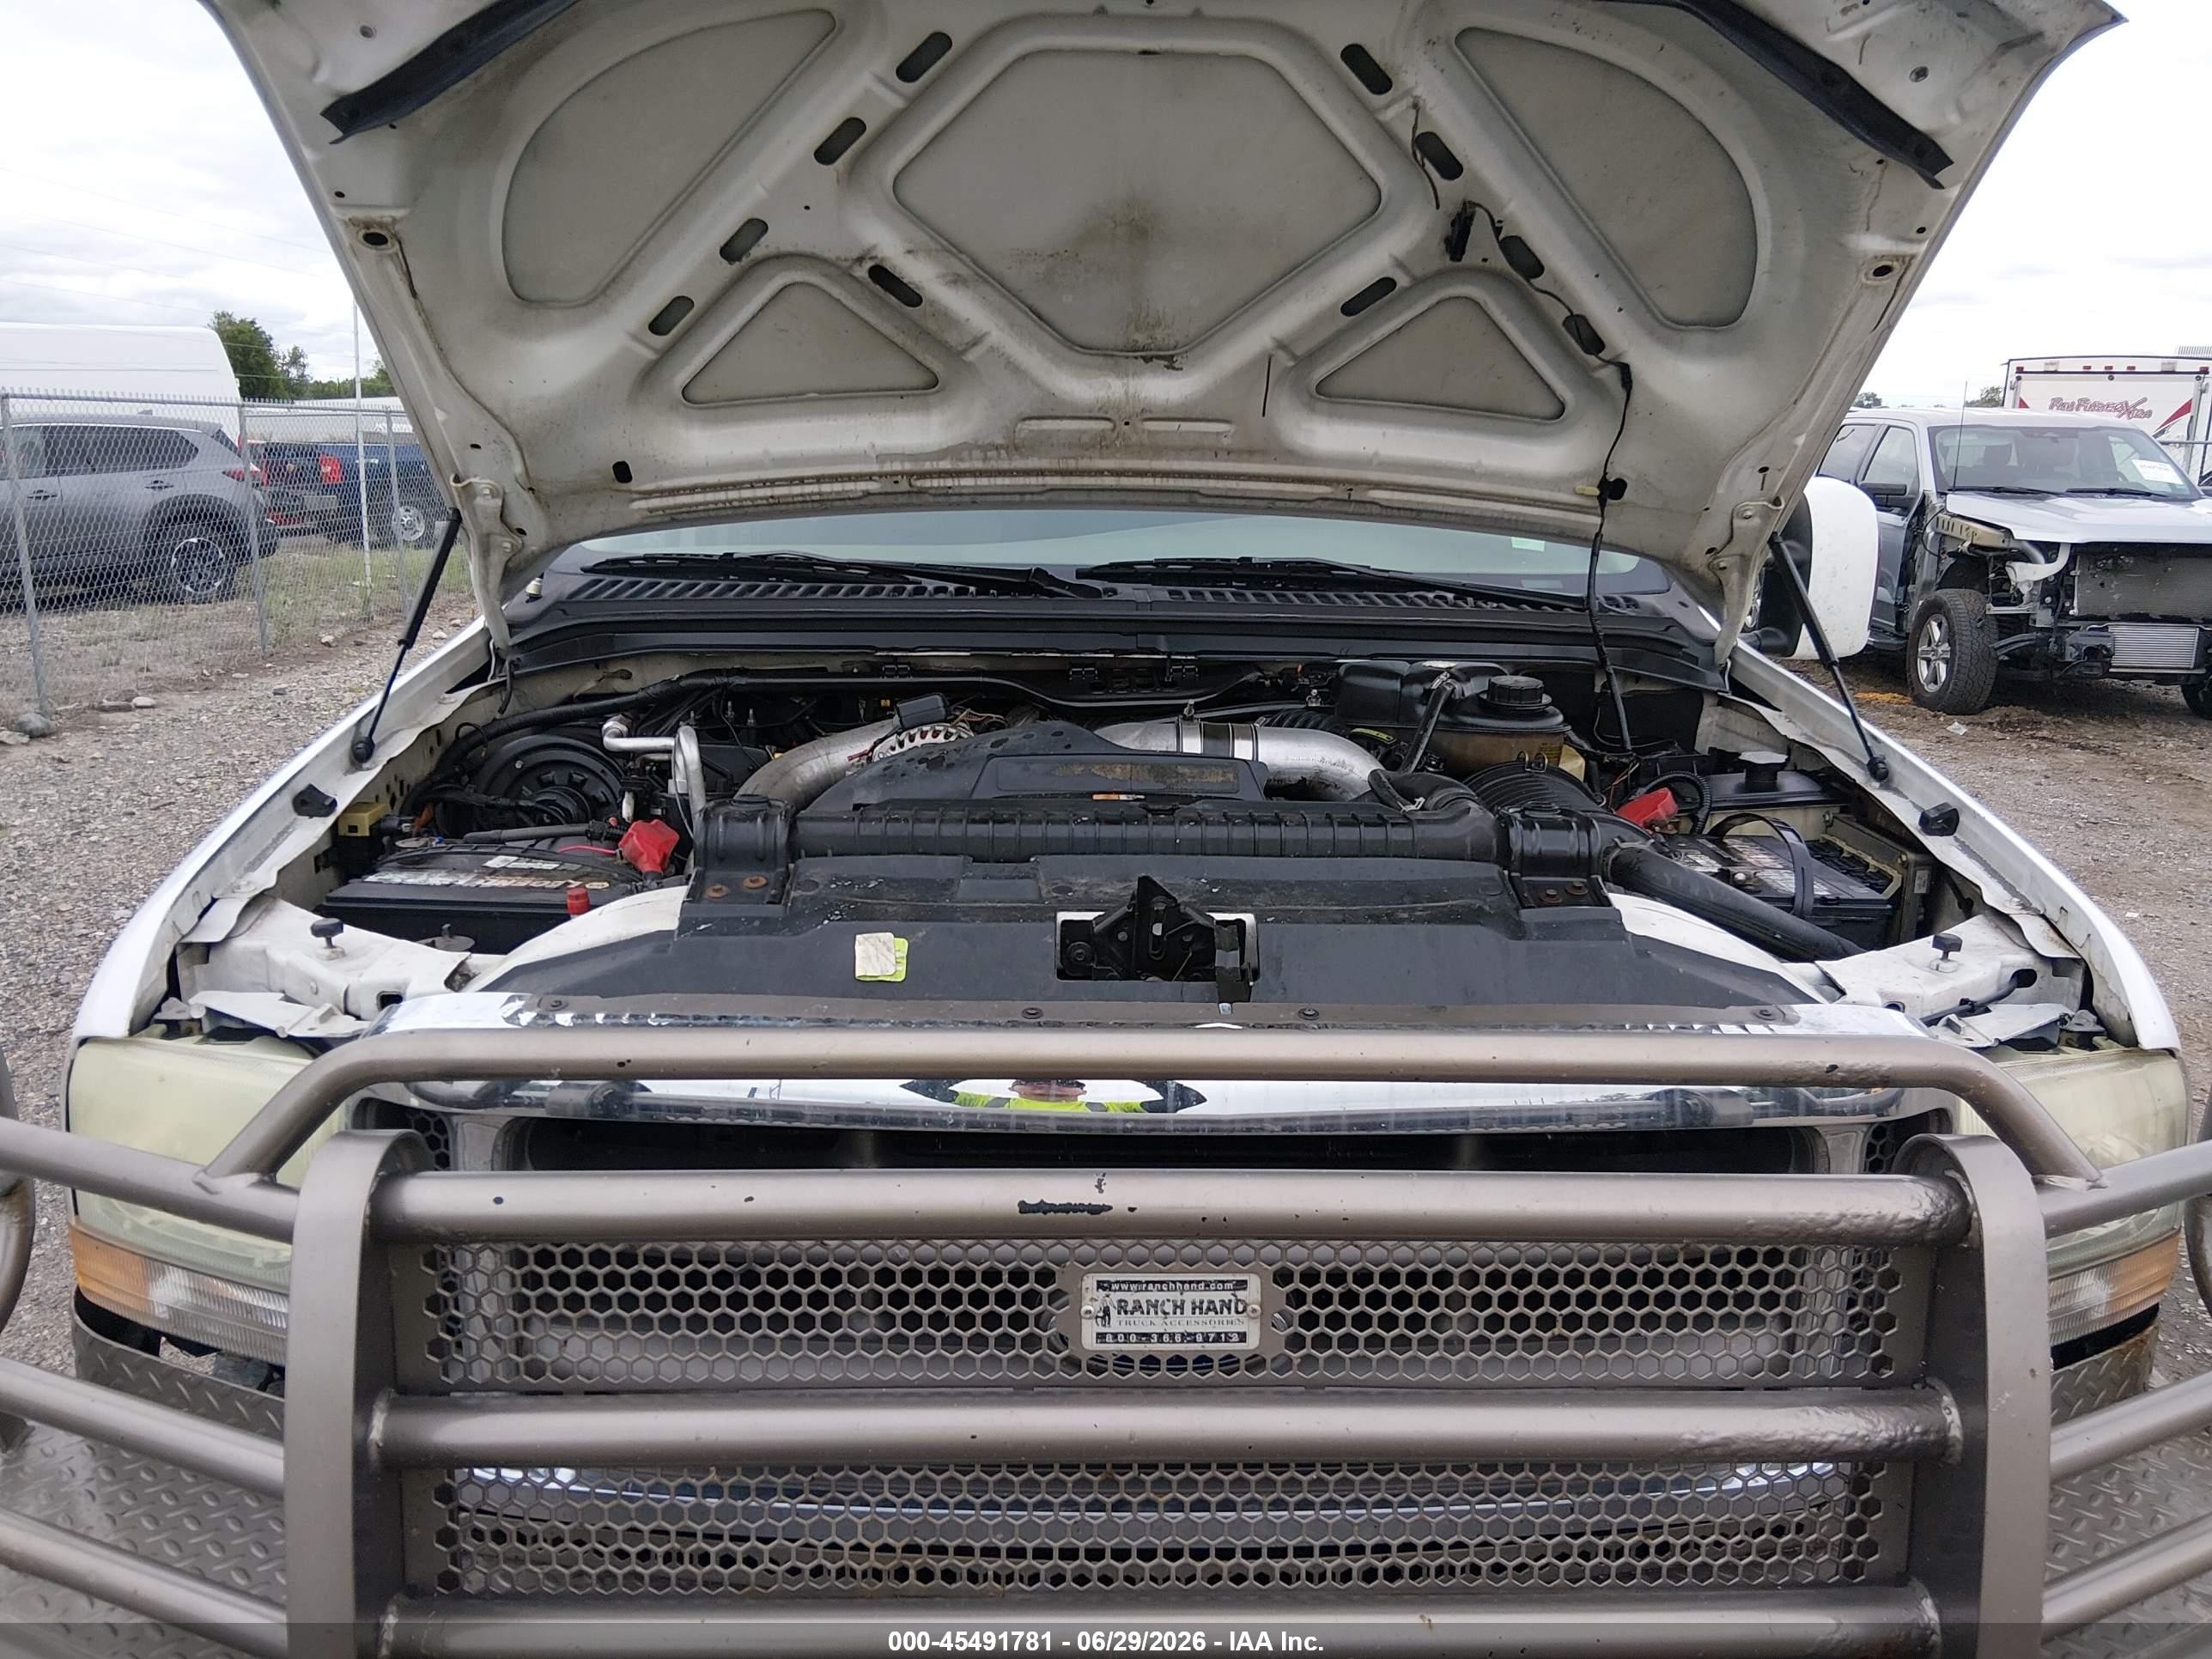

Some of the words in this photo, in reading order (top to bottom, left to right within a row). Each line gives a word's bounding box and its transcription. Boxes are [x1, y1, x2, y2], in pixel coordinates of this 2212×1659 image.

[1110, 1280, 1235, 1291] www.ranchhand.com
[1116, 1298, 1186, 1316] RANCH
[1190, 1297, 1247, 1316] HAND
[1117, 1319, 1157, 1328] TRUCK
[1159, 1317, 1245, 1328] ACCESSORIES
[1105, 1333, 1240, 1343] 800-366-9712
